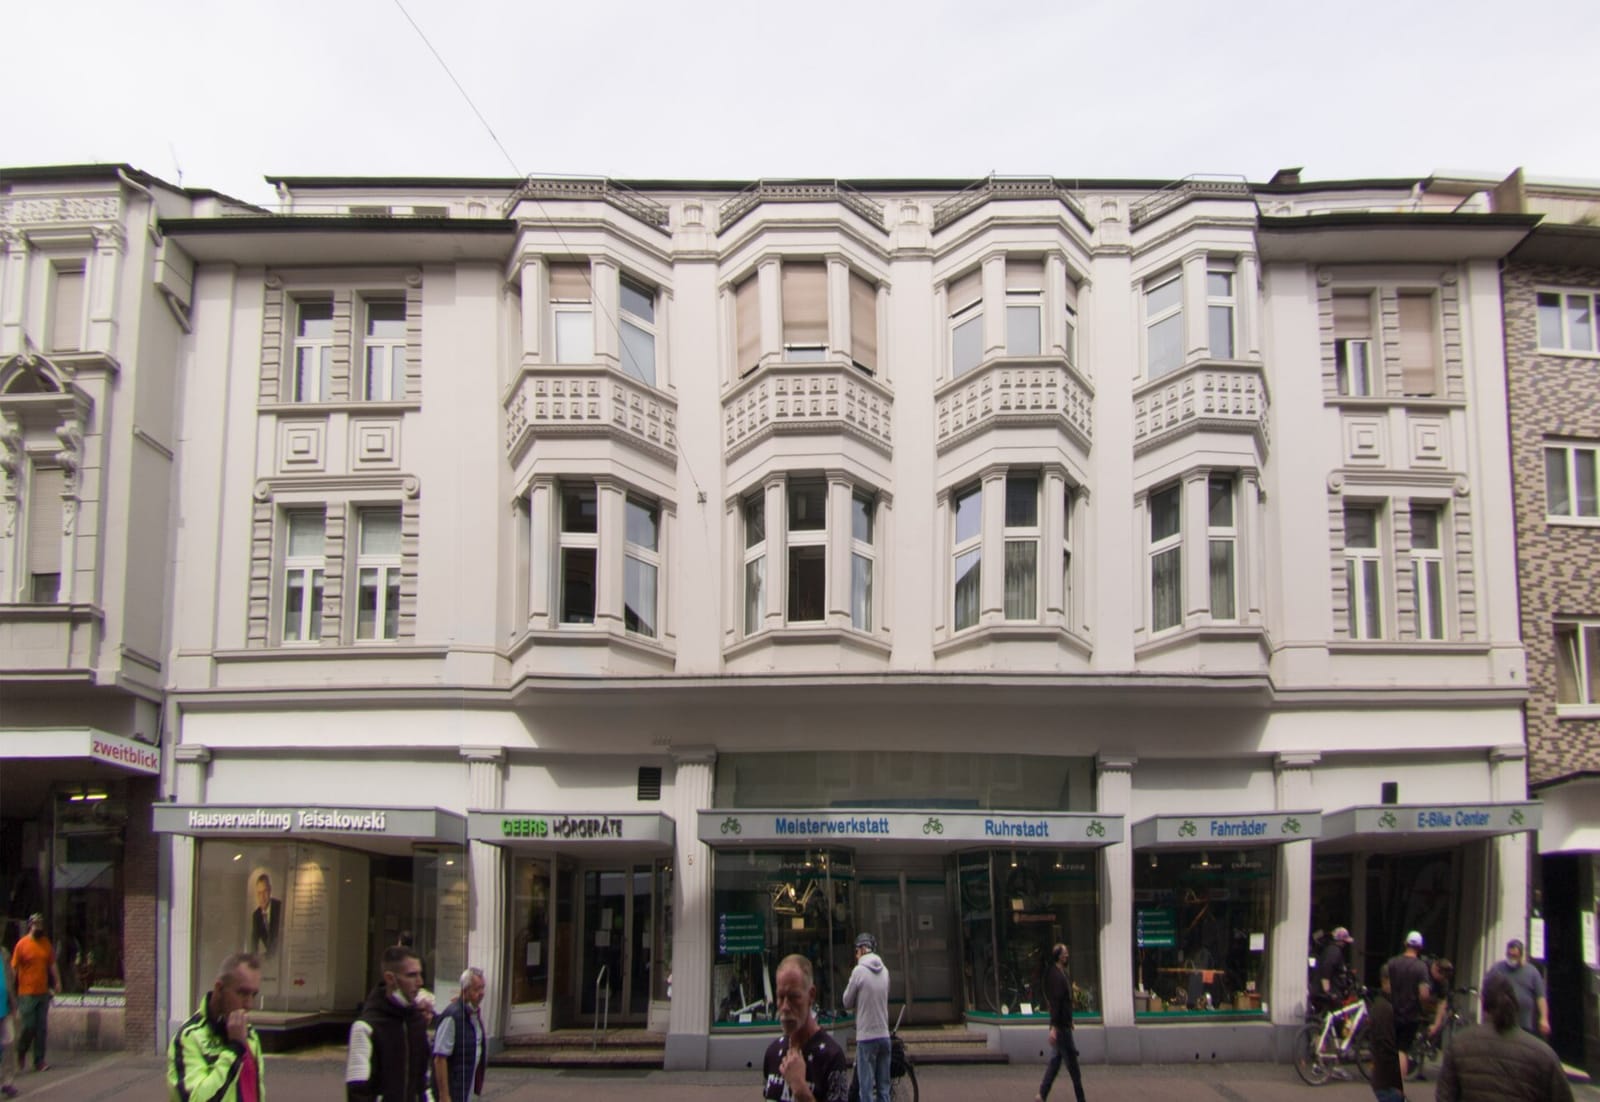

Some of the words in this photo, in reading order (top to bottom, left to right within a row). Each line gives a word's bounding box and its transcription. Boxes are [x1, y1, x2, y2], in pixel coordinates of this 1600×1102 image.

[92, 740, 158, 769] zweitblick
[188, 809, 292, 831] Hausverwaltung
[298, 810, 386, 831] Teisakowski
[502, 818, 548, 837] GEERS
[775, 817, 890, 834] Meisterwerkstatt
[1417, 812, 1452, 828] E-Bike
[1455, 811, 1490, 827] Center
[985, 820, 1049, 837] Ruhrstadt
[1210, 820, 1267, 837] Fahrräder
